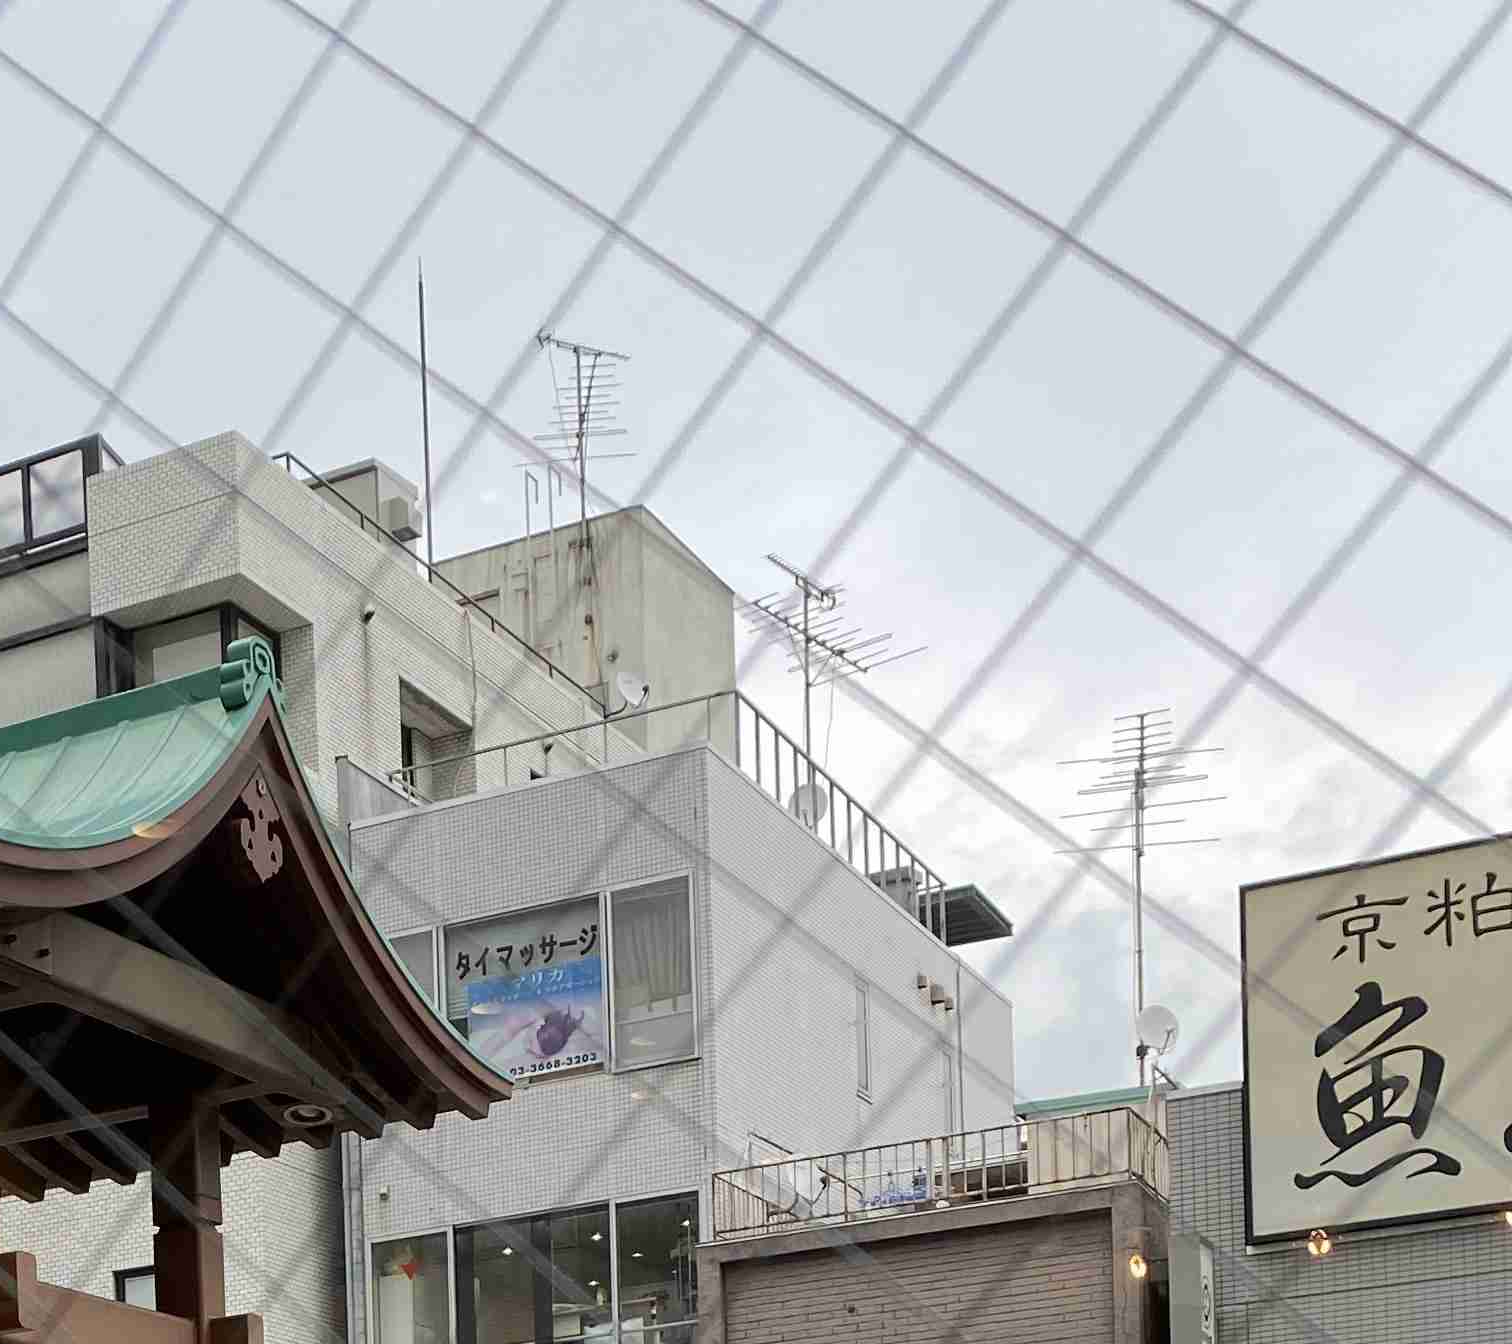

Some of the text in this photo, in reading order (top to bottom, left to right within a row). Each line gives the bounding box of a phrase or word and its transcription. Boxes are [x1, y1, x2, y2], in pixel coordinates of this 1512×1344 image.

[456, 925, 598, 981] タイマッサージ
